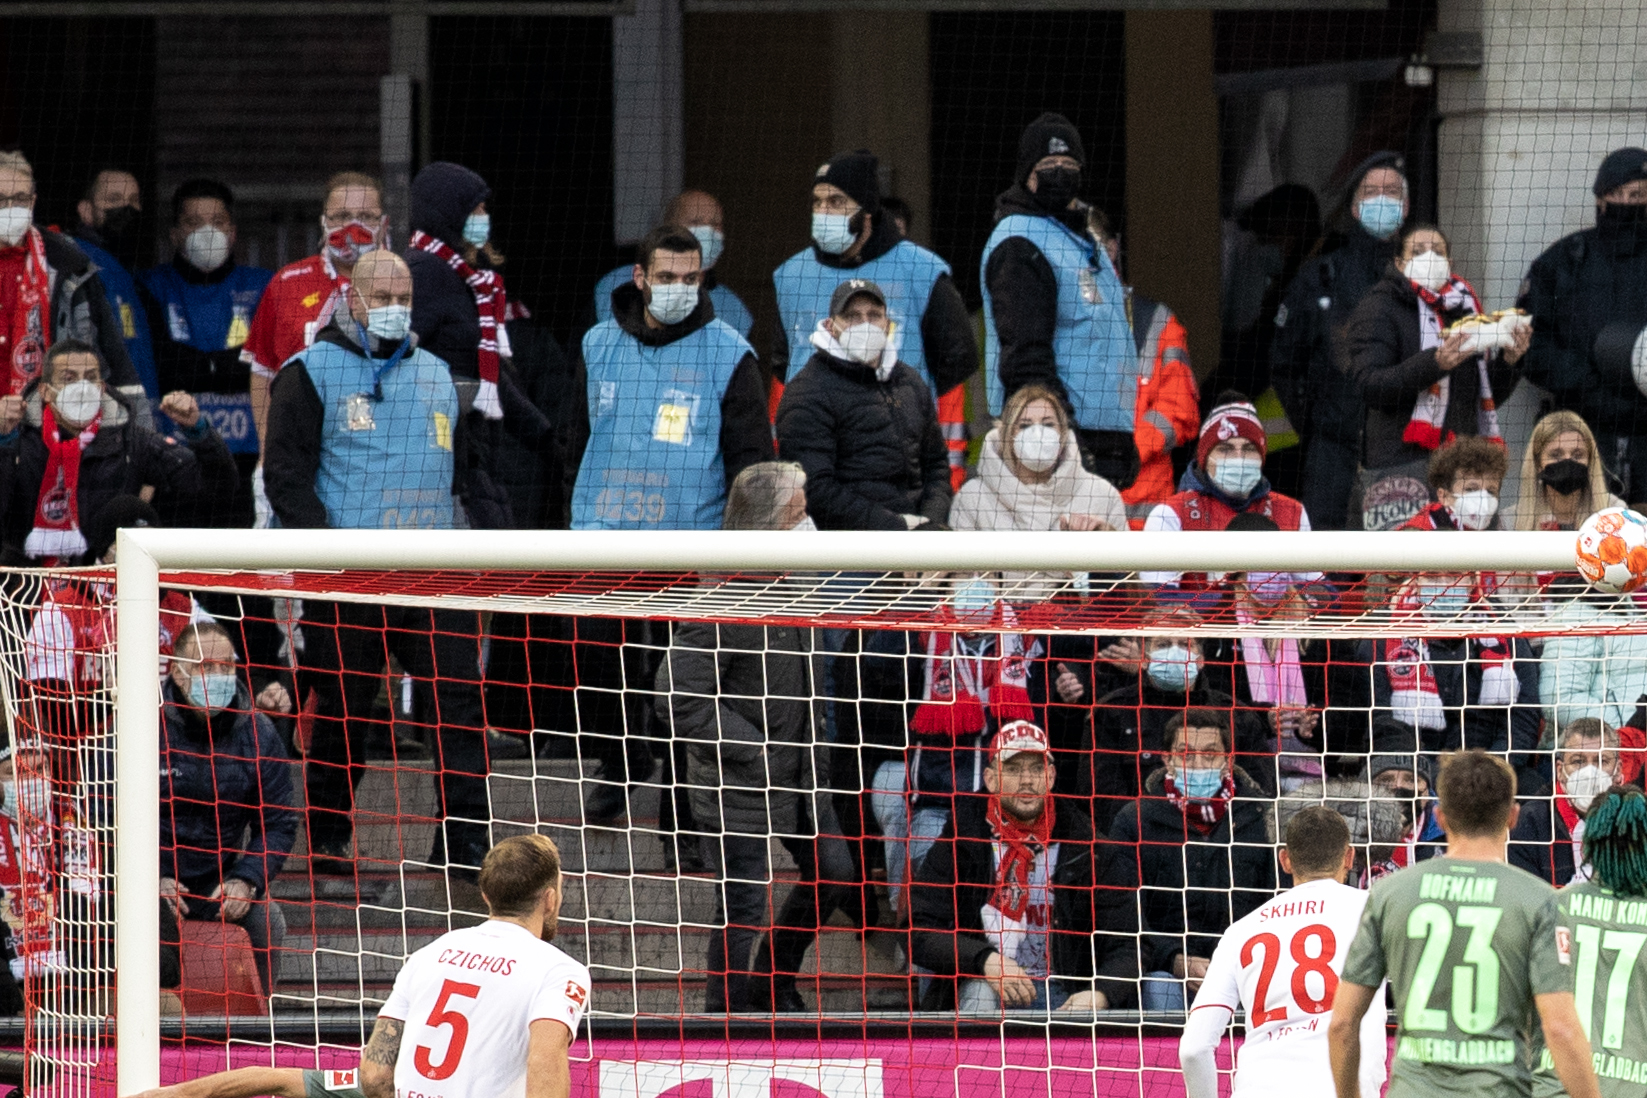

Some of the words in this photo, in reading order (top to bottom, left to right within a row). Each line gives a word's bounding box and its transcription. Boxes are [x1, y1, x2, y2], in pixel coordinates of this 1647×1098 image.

[1419, 873, 1498, 904] HOFMANN
[1260, 900, 1325, 923] SKHIRI
[1569, 893, 1613, 922] MANU
[438, 948, 517, 977] CZICHOS
[1240, 923, 1340, 1029] 28
[1403, 902, 1504, 1034] 23
[413, 978, 481, 1081] 5
